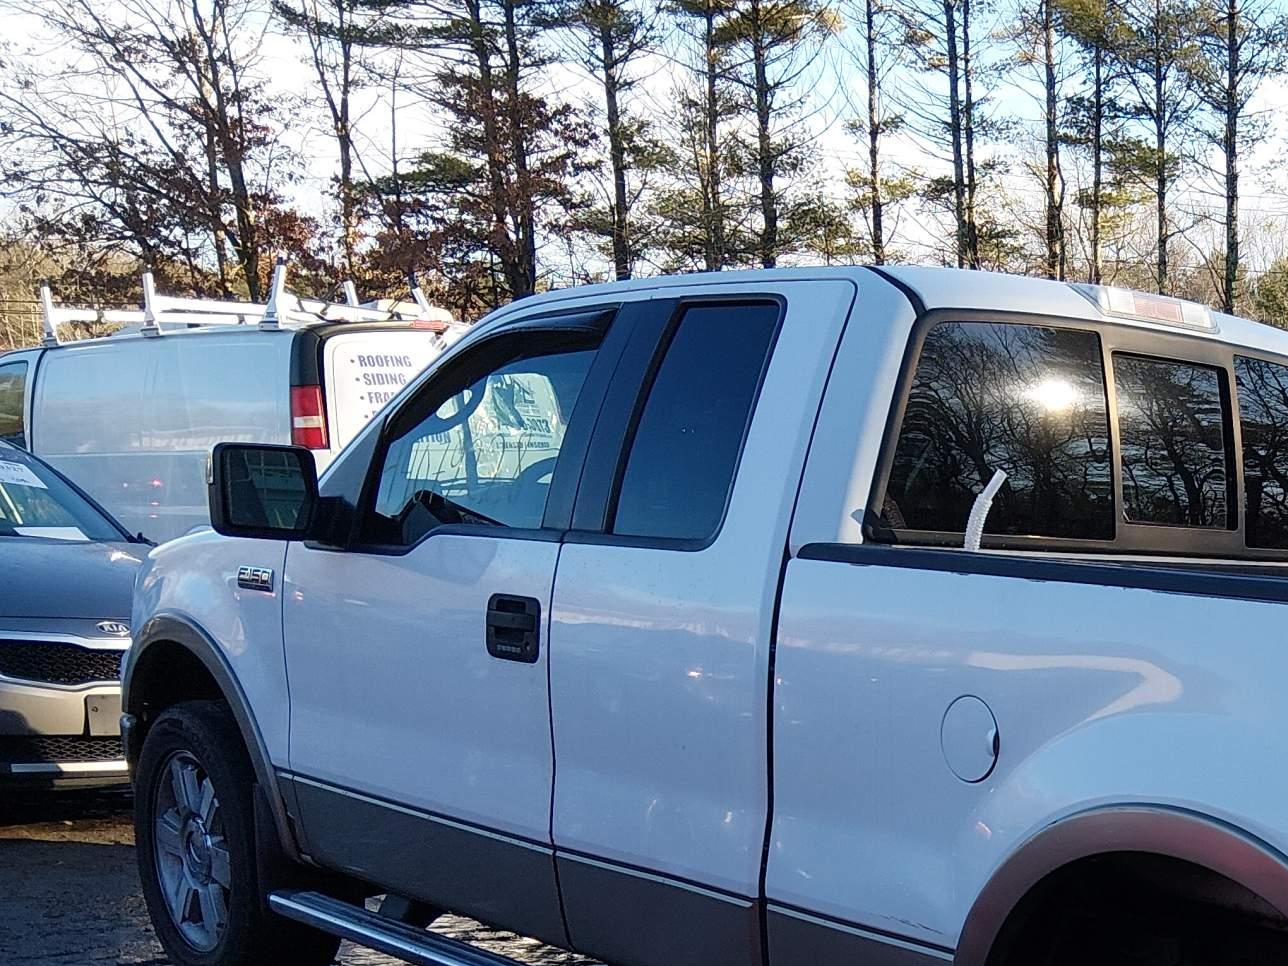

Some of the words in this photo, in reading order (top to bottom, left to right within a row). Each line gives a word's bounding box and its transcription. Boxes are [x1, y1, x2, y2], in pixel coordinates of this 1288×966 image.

[357, 355, 413, 368] ROOFING
[363, 373, 407, 386] SIDING
[238, 567, 272, 587] F150
[102, 623, 128, 632] KIA
